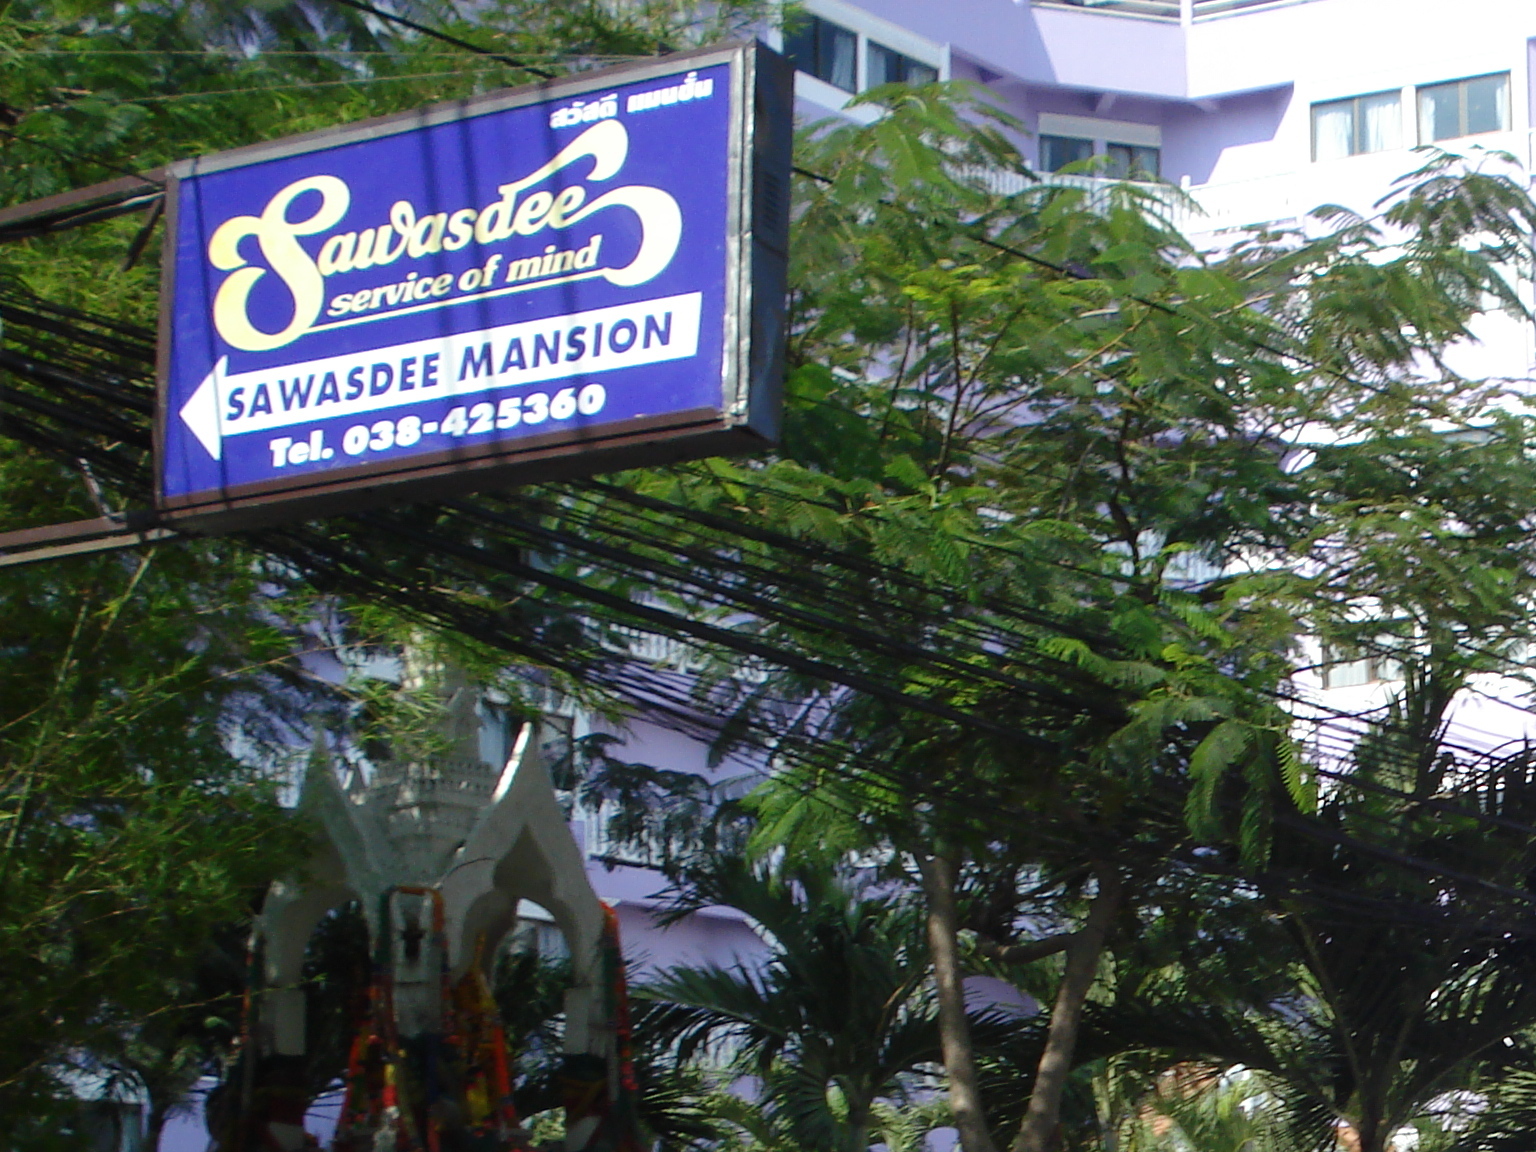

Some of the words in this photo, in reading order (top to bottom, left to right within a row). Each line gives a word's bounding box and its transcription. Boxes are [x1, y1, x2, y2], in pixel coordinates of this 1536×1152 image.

[208, 119, 682, 351] Sawasdee
[327, 272, 453, 316] service
[458, 255, 502, 291] of
[505, 235, 602, 282] mind
[226, 352, 440, 422] SAWASDEE
[457, 311, 674, 382] MANSION
[269, 431, 334, 468] Tel.
[343, 383, 606, 457] 038-425360
